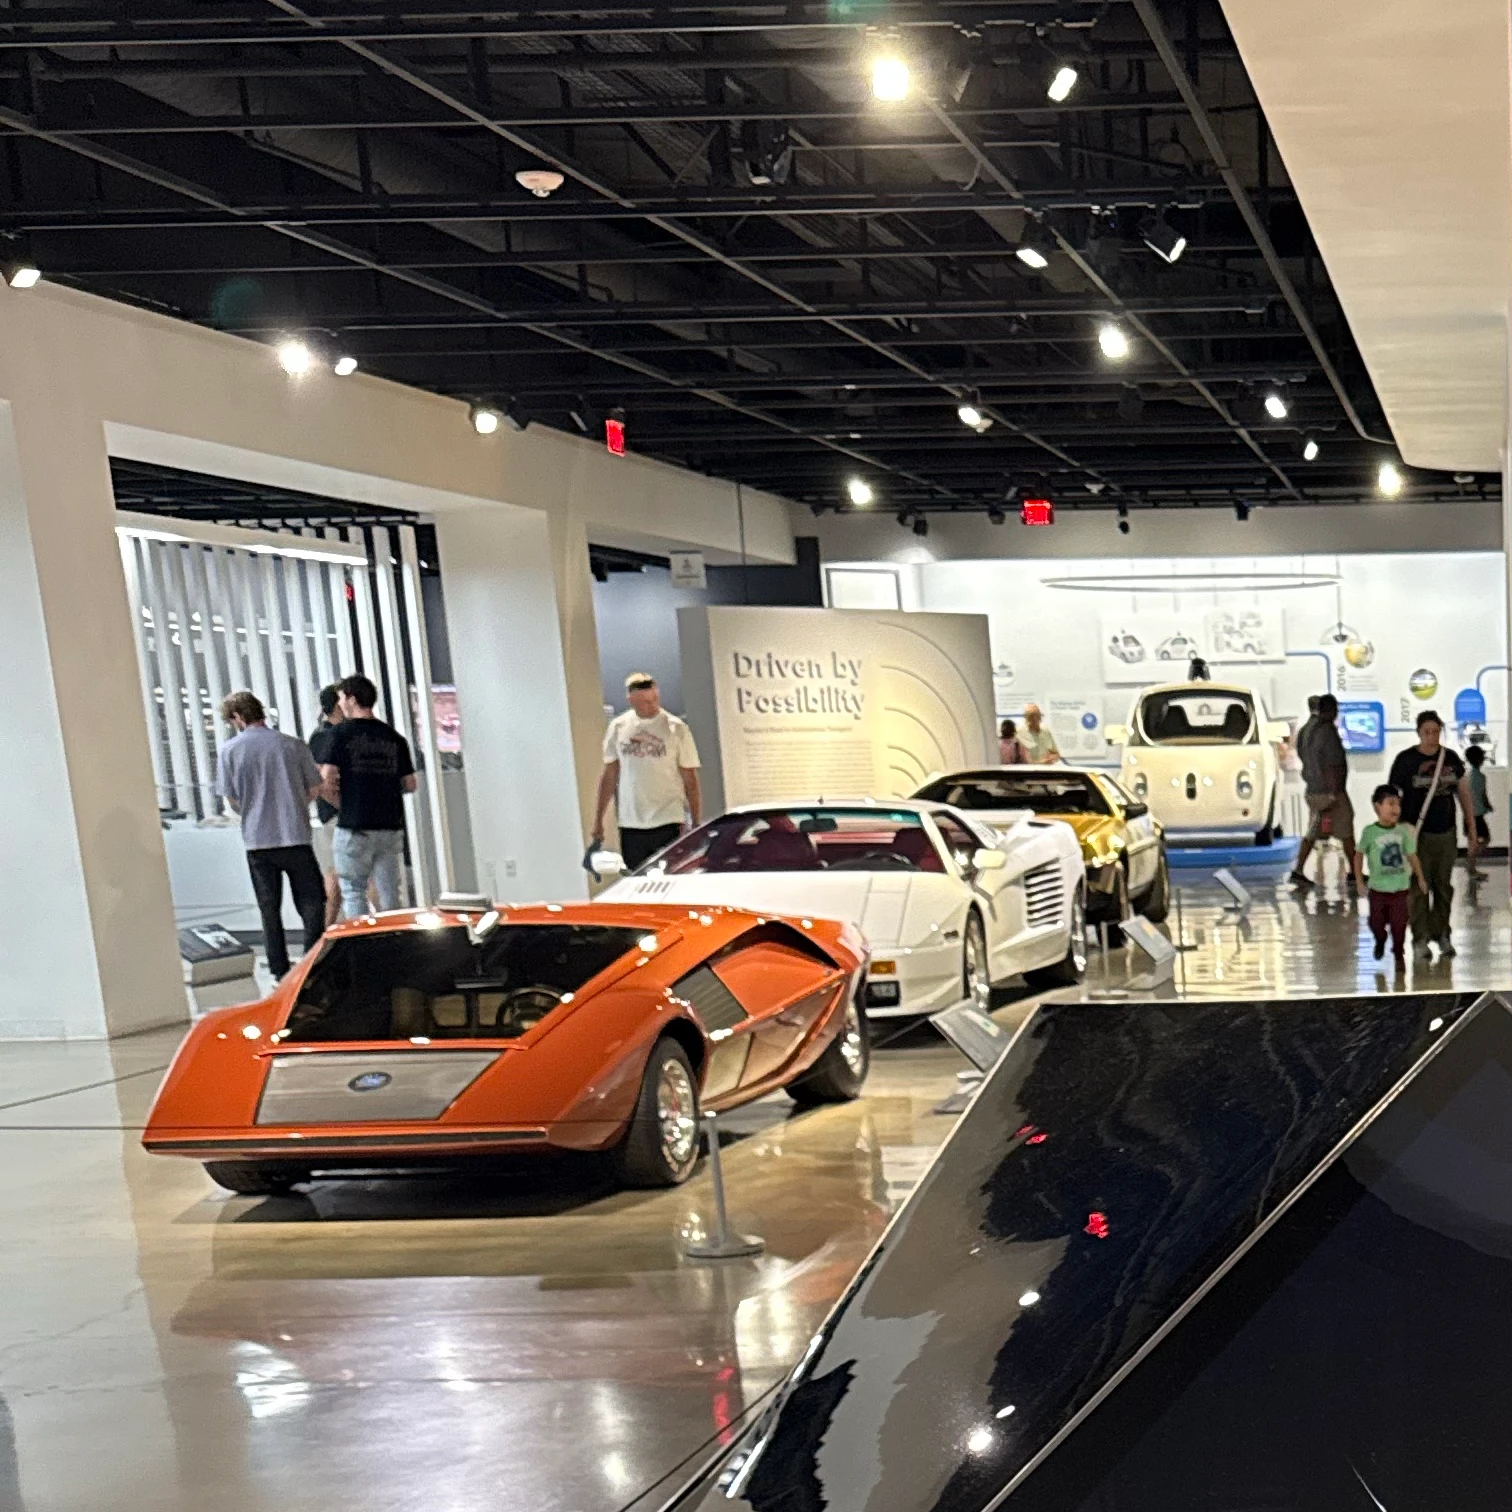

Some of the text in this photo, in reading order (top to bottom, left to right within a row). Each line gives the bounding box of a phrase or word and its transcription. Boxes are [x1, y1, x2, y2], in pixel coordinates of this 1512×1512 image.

[733, 651, 863, 686] Driven by
[1336, 665, 1347, 692] 2016
[735, 685, 865, 720] Possibility
[1400, 697, 1411, 723] 2017
